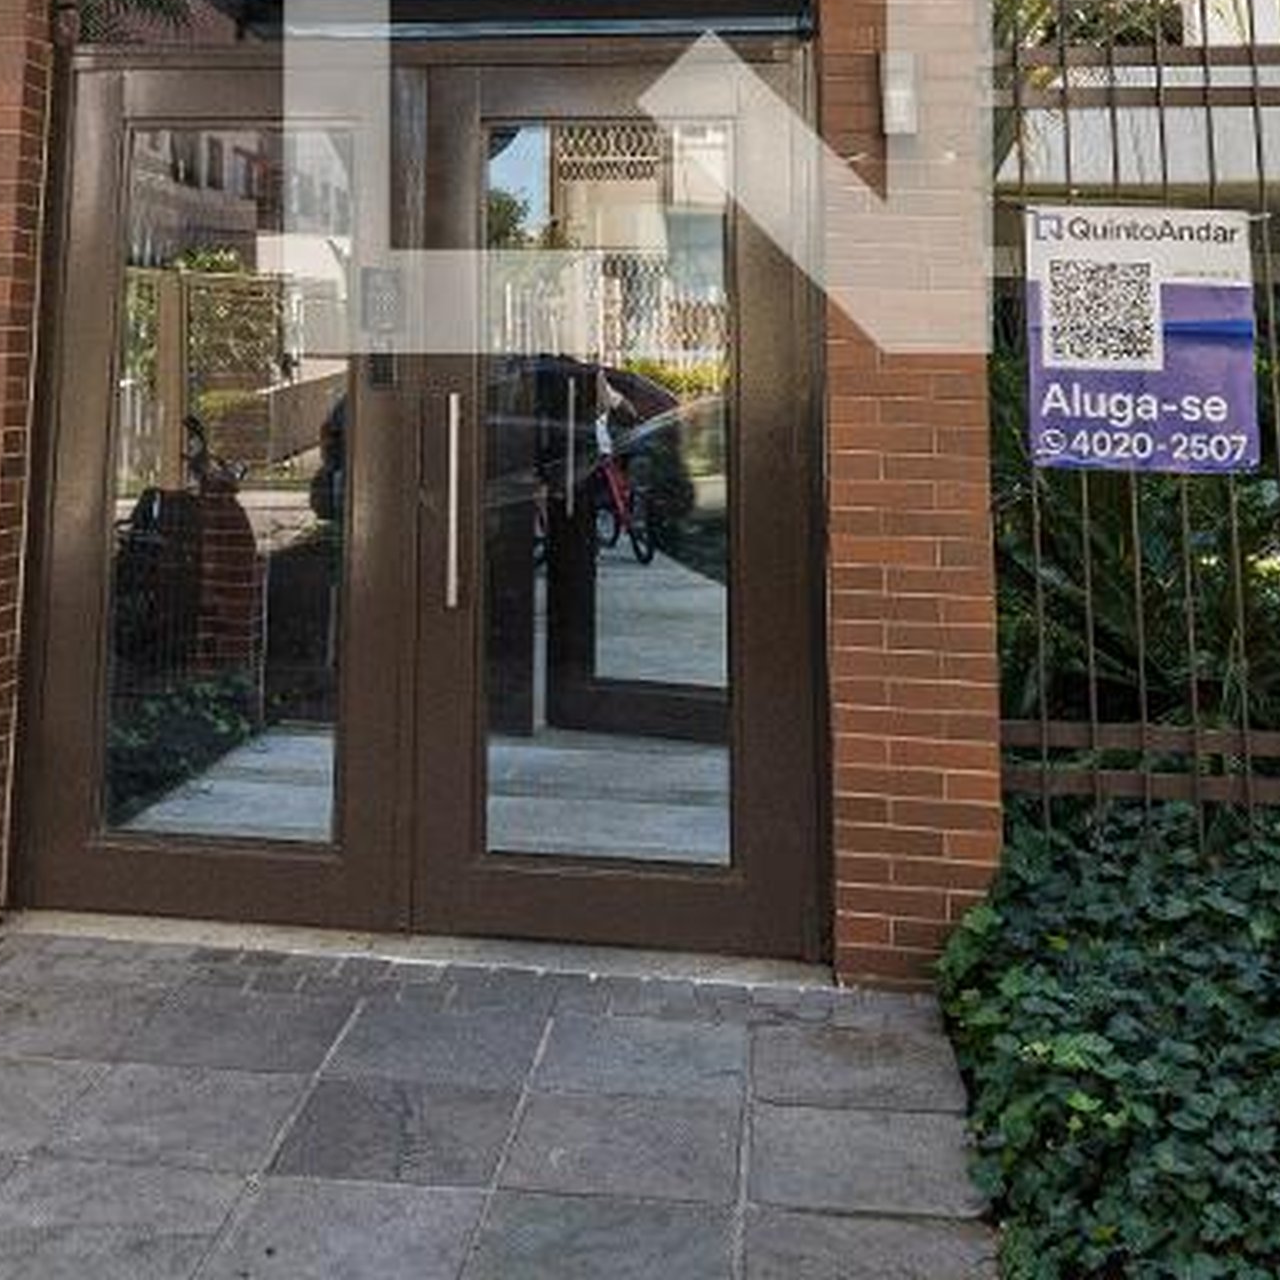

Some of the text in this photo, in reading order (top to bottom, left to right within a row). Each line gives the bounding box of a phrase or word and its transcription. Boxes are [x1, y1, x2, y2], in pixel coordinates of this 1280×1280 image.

[1068, 217, 1240, 243] QuintoAndar
[1041, 383, 1228, 427] Aluga-se
[1071, 430, 1247, 461] 4020-2507
